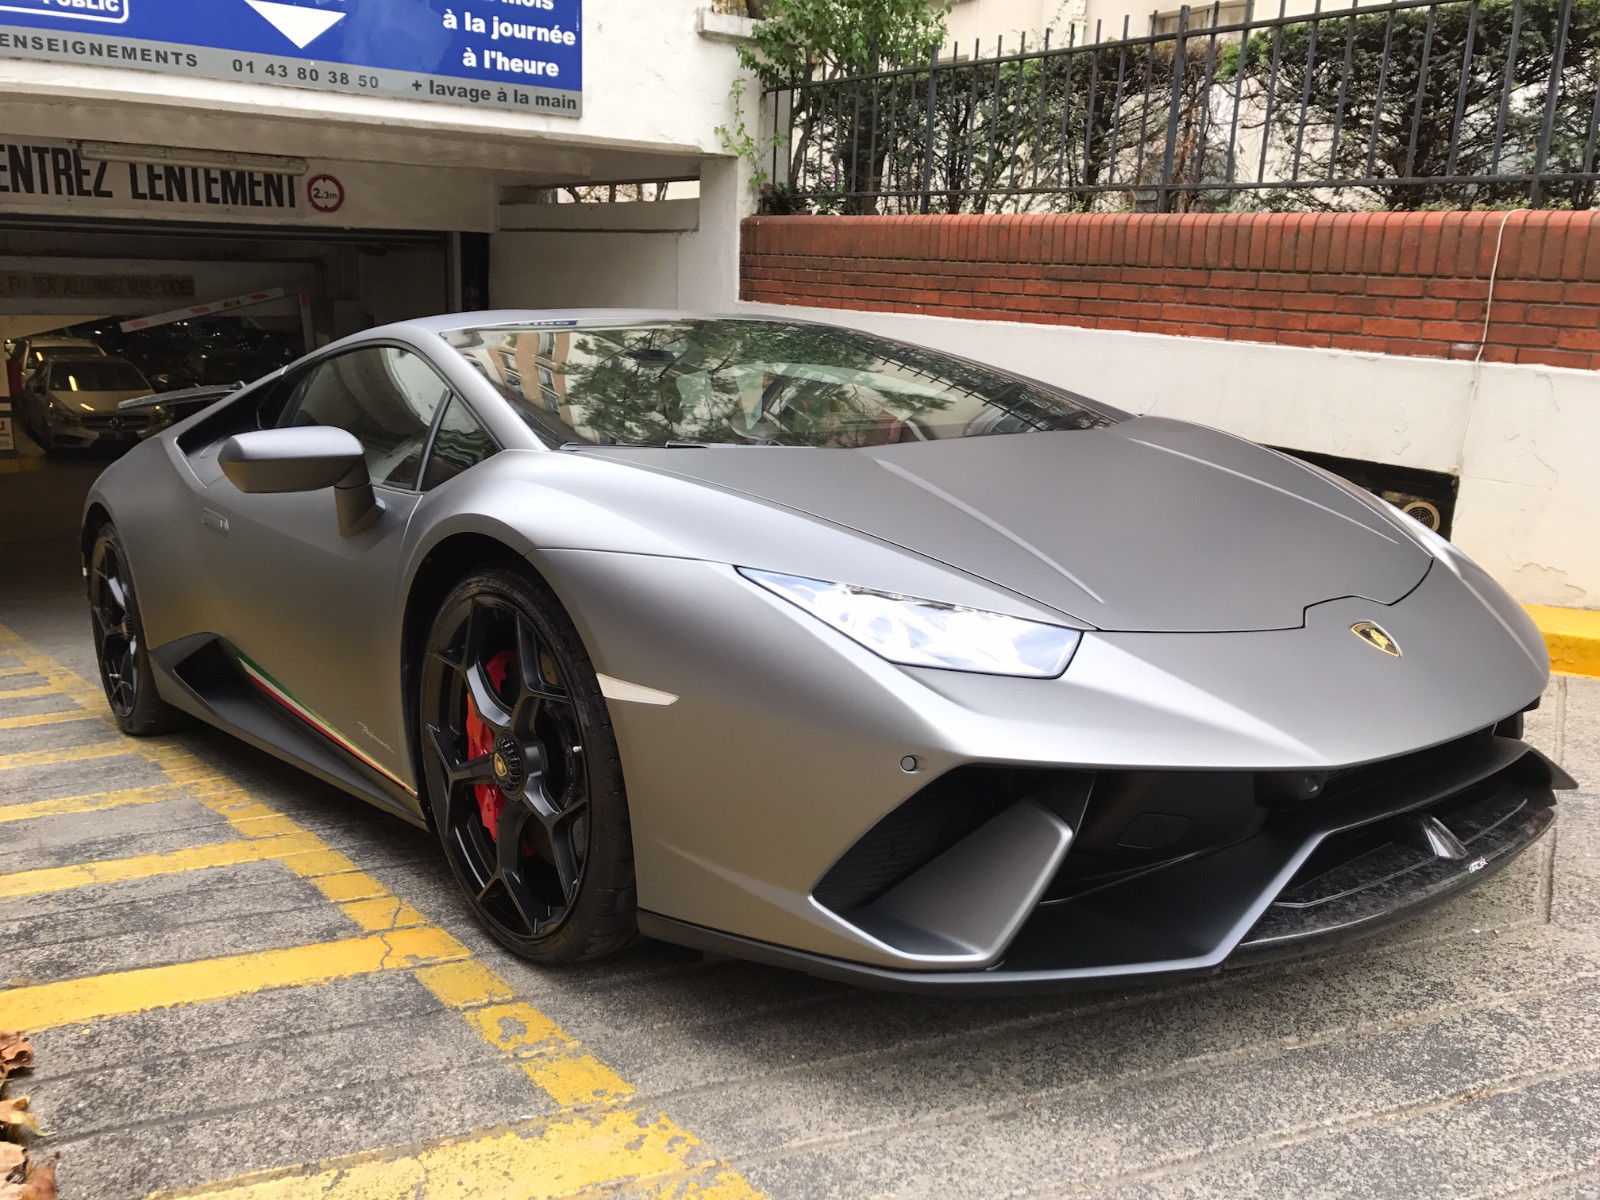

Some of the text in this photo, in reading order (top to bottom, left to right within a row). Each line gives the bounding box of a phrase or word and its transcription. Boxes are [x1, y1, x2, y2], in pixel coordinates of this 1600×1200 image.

[442, 8, 458, 30] à
[464, 11, 486, 33] la
[491, 15, 576, 46] journée
[0, 33, 379, 89] ENSEIGNEMENTS 01 43 80 38 50
[462, 46, 560, 77] à l'heure
[429, 79, 491, 103] lavage
[497, 86, 507, 102] à
[514, 89, 529, 105] la
[535, 94, 576, 110] main
